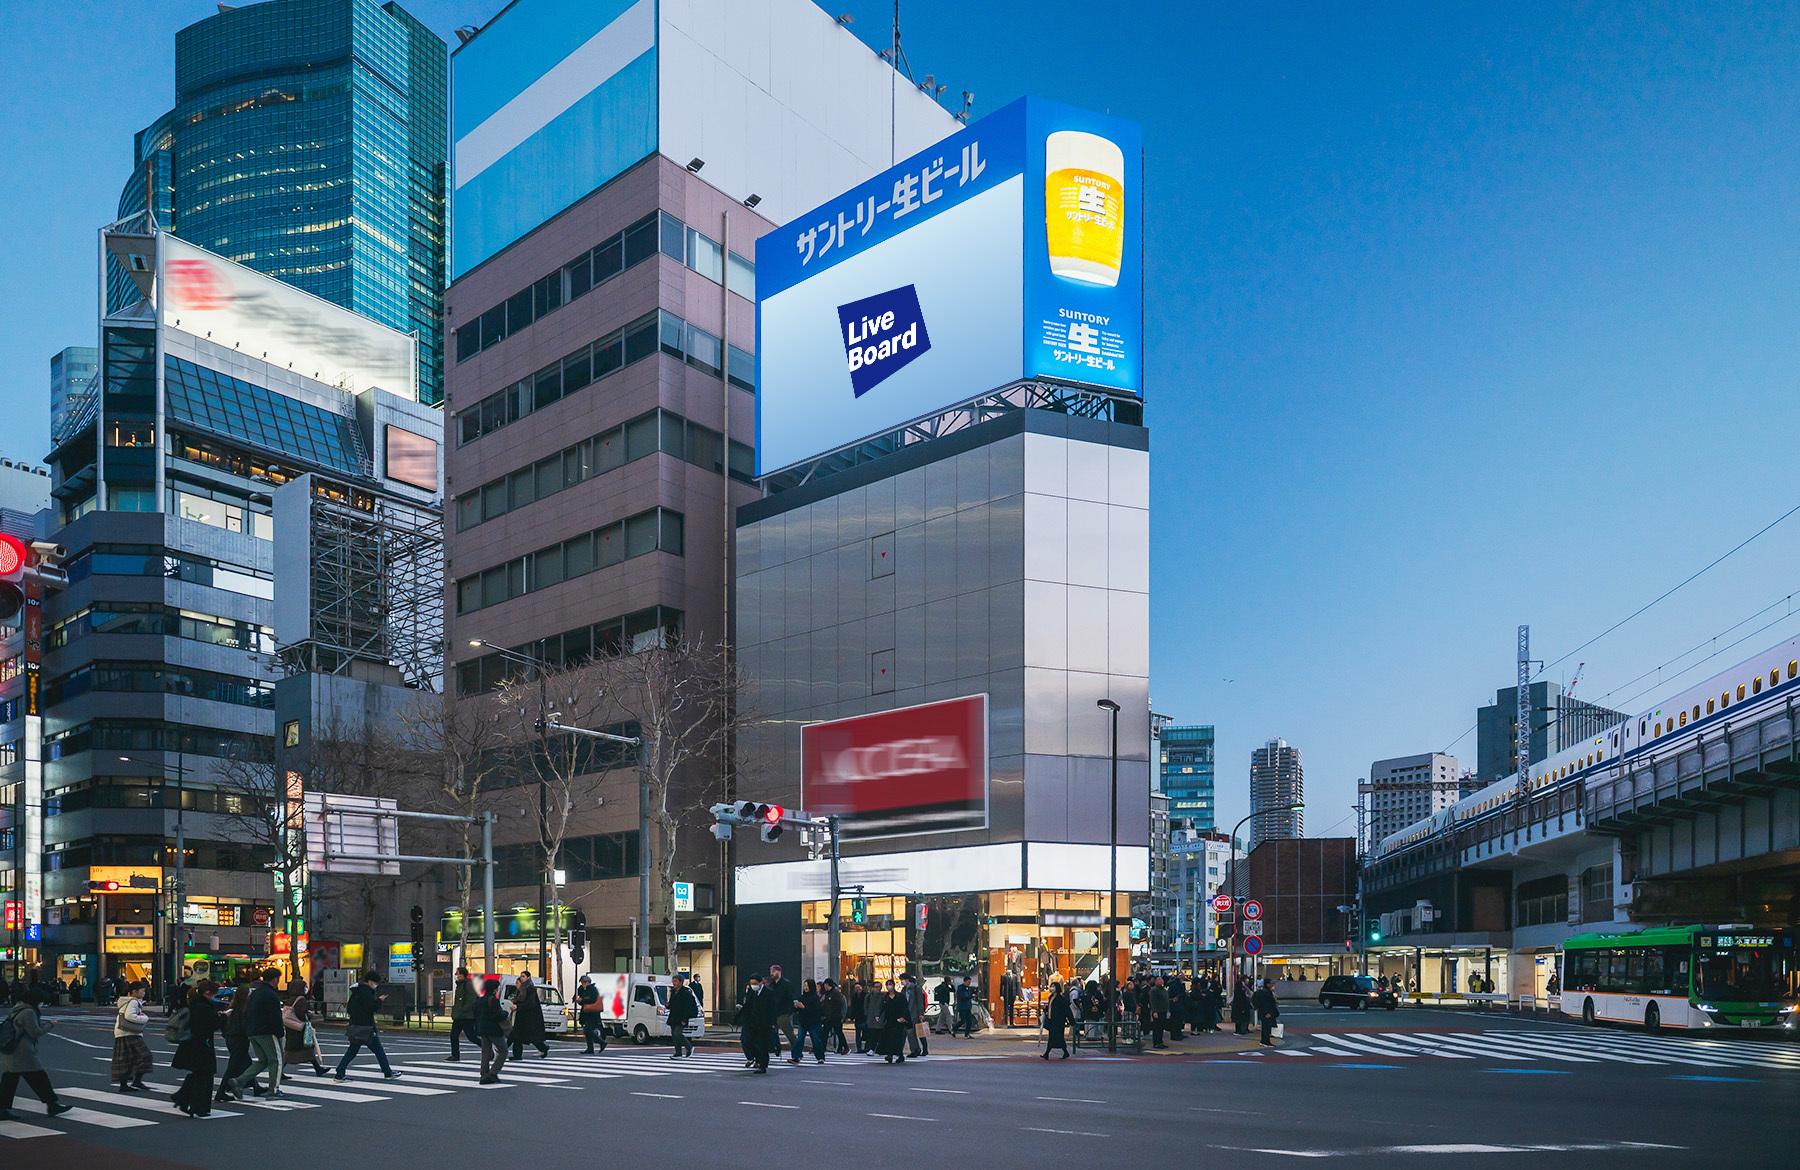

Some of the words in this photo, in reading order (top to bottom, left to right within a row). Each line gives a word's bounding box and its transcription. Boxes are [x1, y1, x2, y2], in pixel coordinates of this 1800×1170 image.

[796, 141, 986, 266] サントリー生ビール
[1079, 185, 1106, 216] 生
[848, 310, 895, 346] Live
[1059, 308, 1110, 326] SUNTORY
[848, 321, 917, 372] Board
[1068, 322, 1100, 355] 生
[1053, 349, 1116, 371] サントリー生ビール
